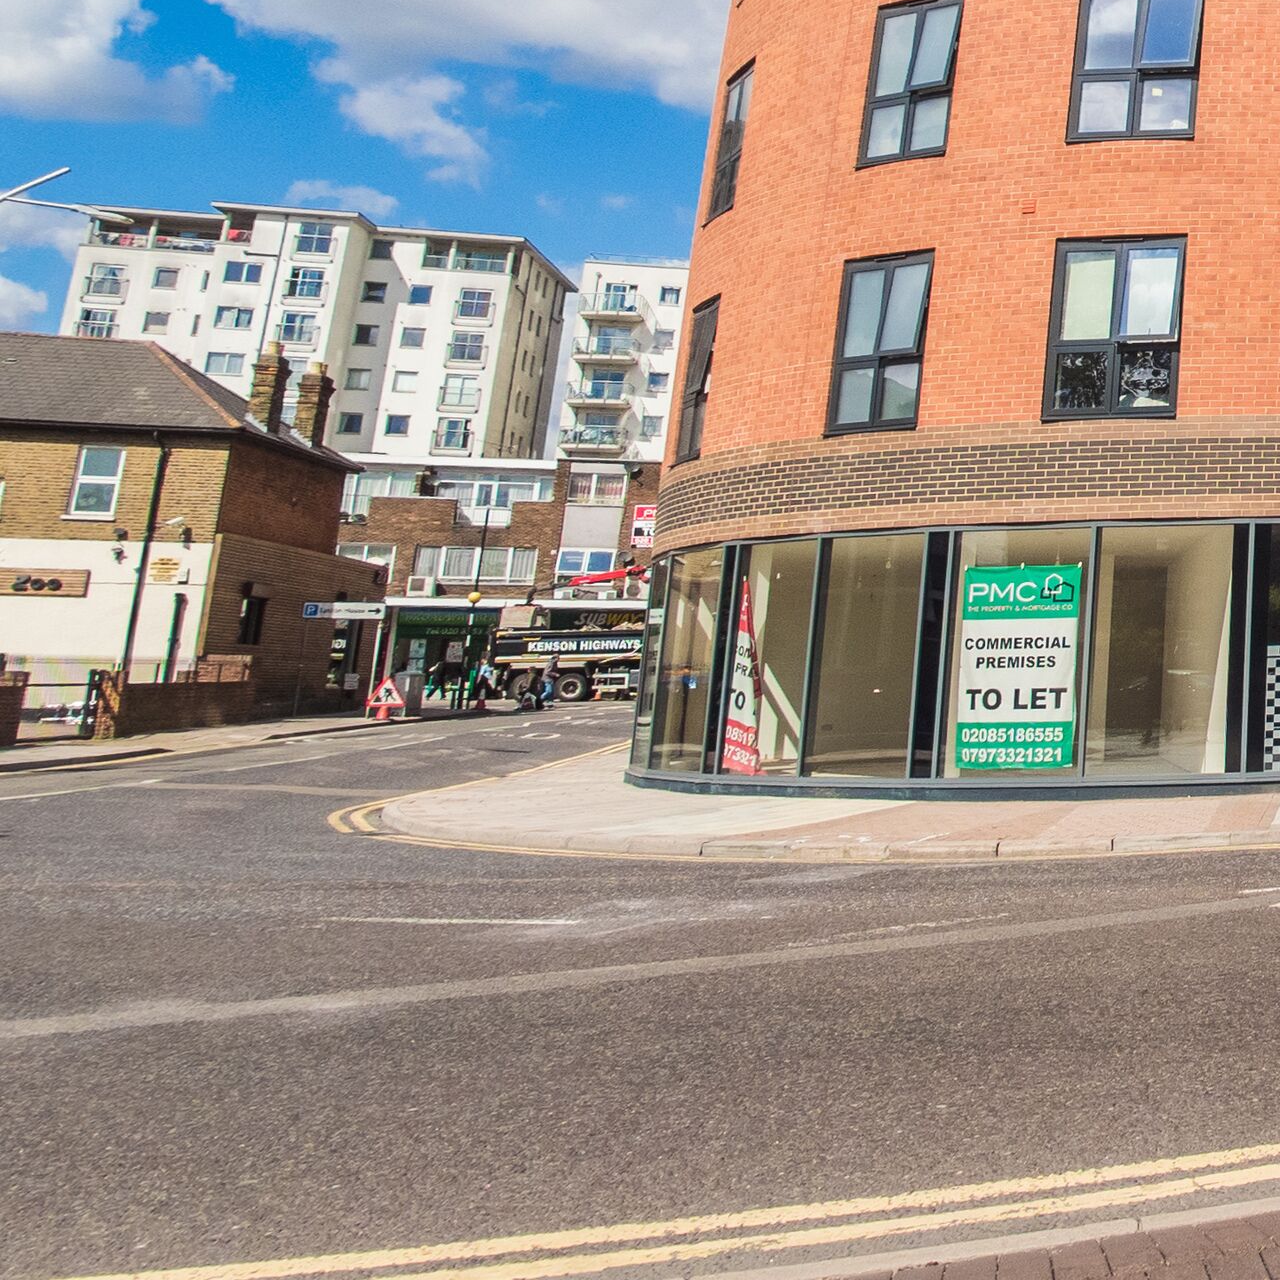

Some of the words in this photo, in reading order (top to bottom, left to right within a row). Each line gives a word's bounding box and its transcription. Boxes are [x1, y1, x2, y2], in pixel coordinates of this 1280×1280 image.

[968, 582, 1037, 603] PMC
[574, 612, 644, 626] SUBWAY
[527, 641, 577, 652] KENSON
[580, 639, 641, 651] HIGHWAYS
[965, 637, 1071, 650] COMMERCIAL
[976, 656, 1056, 669] PREMISES
[966, 688, 1002, 710] TO
[1013, 687, 1067, 710] LET
[961, 727, 1064, 743] 02085186555
[961, 748, 1063, 763] 07973321321
